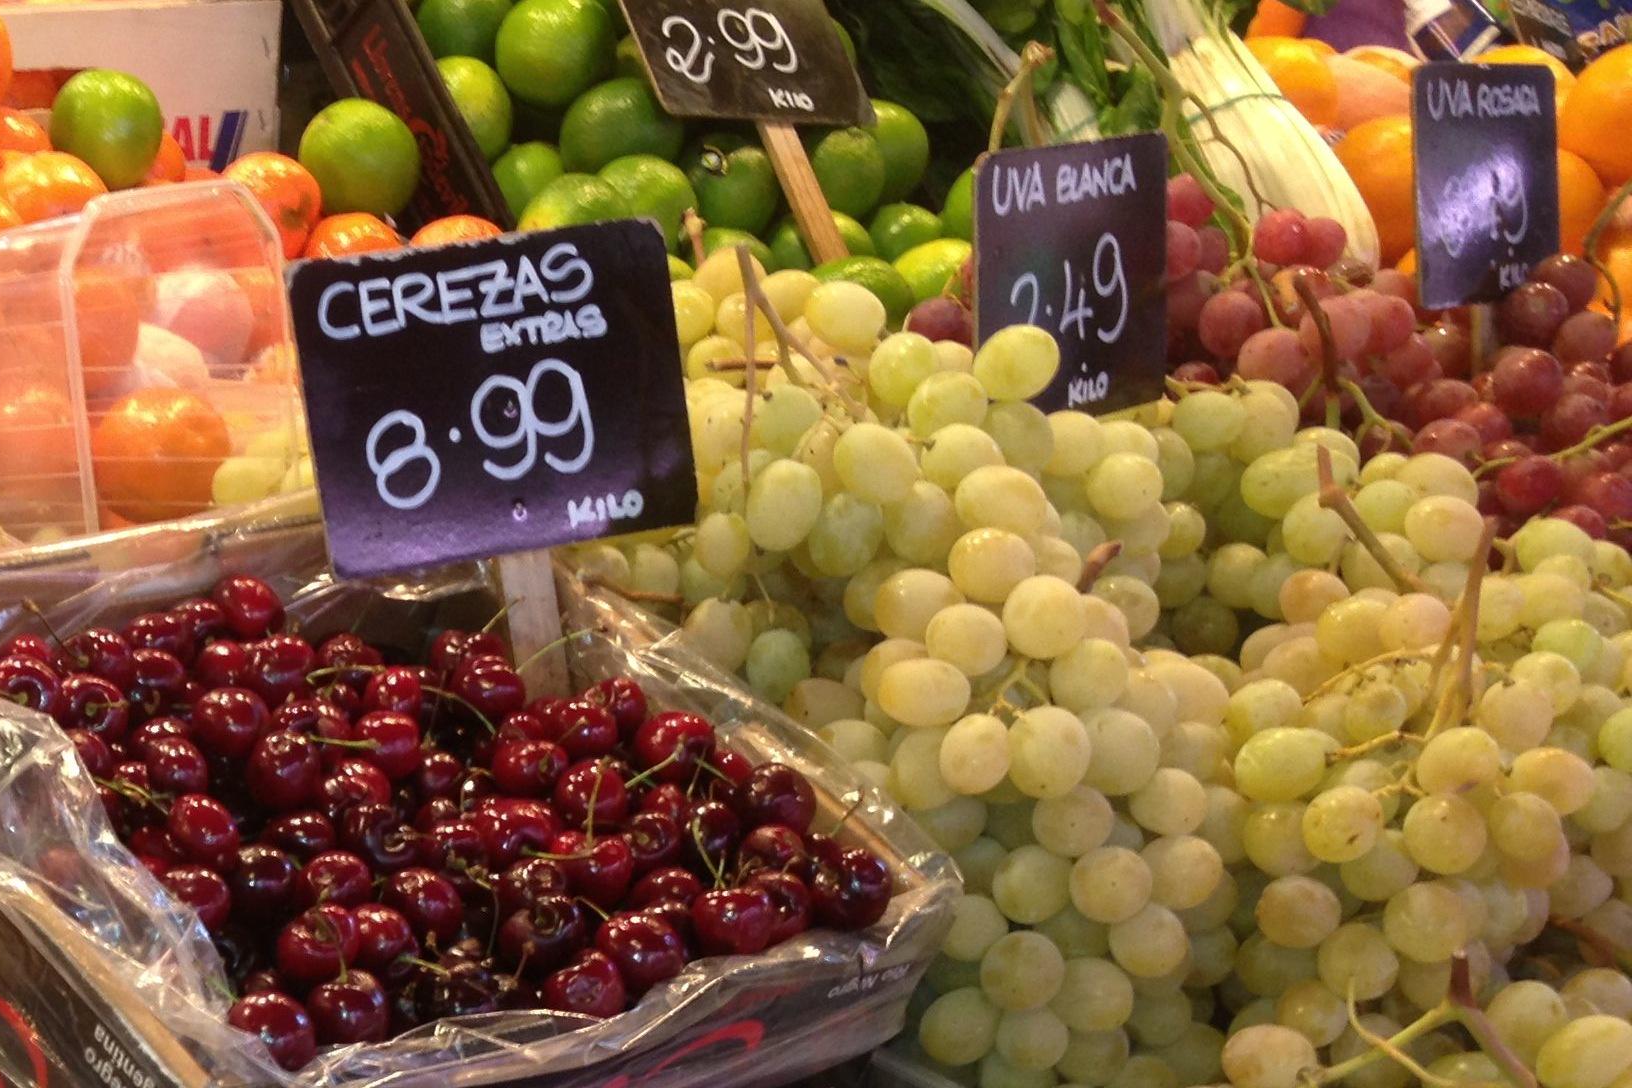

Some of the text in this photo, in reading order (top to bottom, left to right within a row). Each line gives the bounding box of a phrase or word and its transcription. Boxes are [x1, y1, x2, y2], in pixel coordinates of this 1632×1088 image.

[768, 86, 815, 112] KILO
[1427, 77, 1474, 122] UVA
[172, 113, 216, 162] AL
[992, 153, 1137, 217] UVA BLANCA
[317, 242, 595, 341] CEREZAS
[479, 303, 608, 354] EXTRAS
[567, 489, 644, 530] KILO
[83, 1046, 125, 1088] egro
[94, 1023, 156, 1088] gentina
